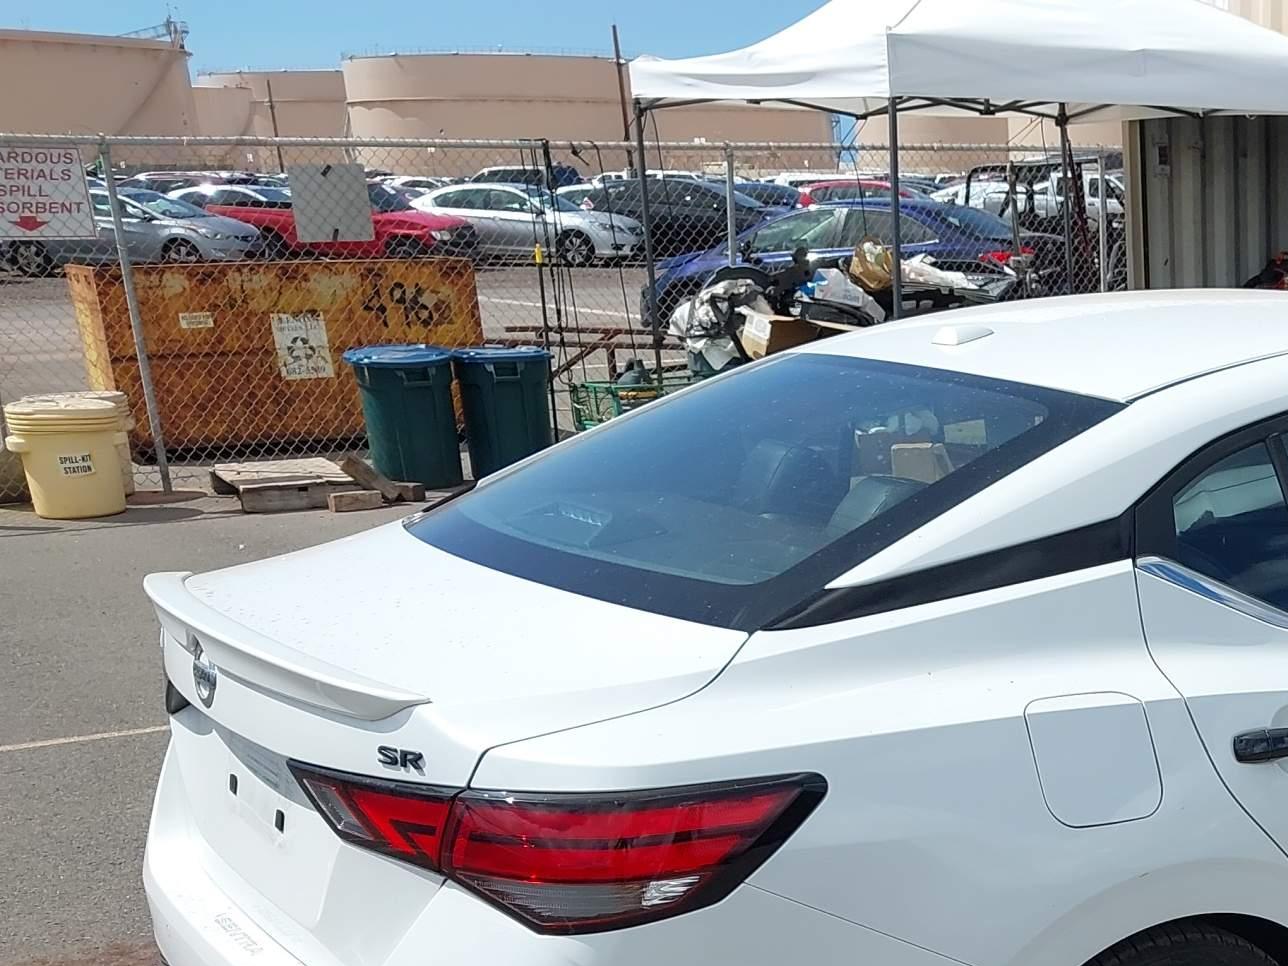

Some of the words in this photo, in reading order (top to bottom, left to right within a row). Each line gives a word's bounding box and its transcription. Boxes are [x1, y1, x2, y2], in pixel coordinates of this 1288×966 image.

[0, 168, 71, 181] ERIALS
[0, 185, 48, 197] SPILL
[63, 465, 92, 475] STATION
[377, 745, 424, 770] SR
